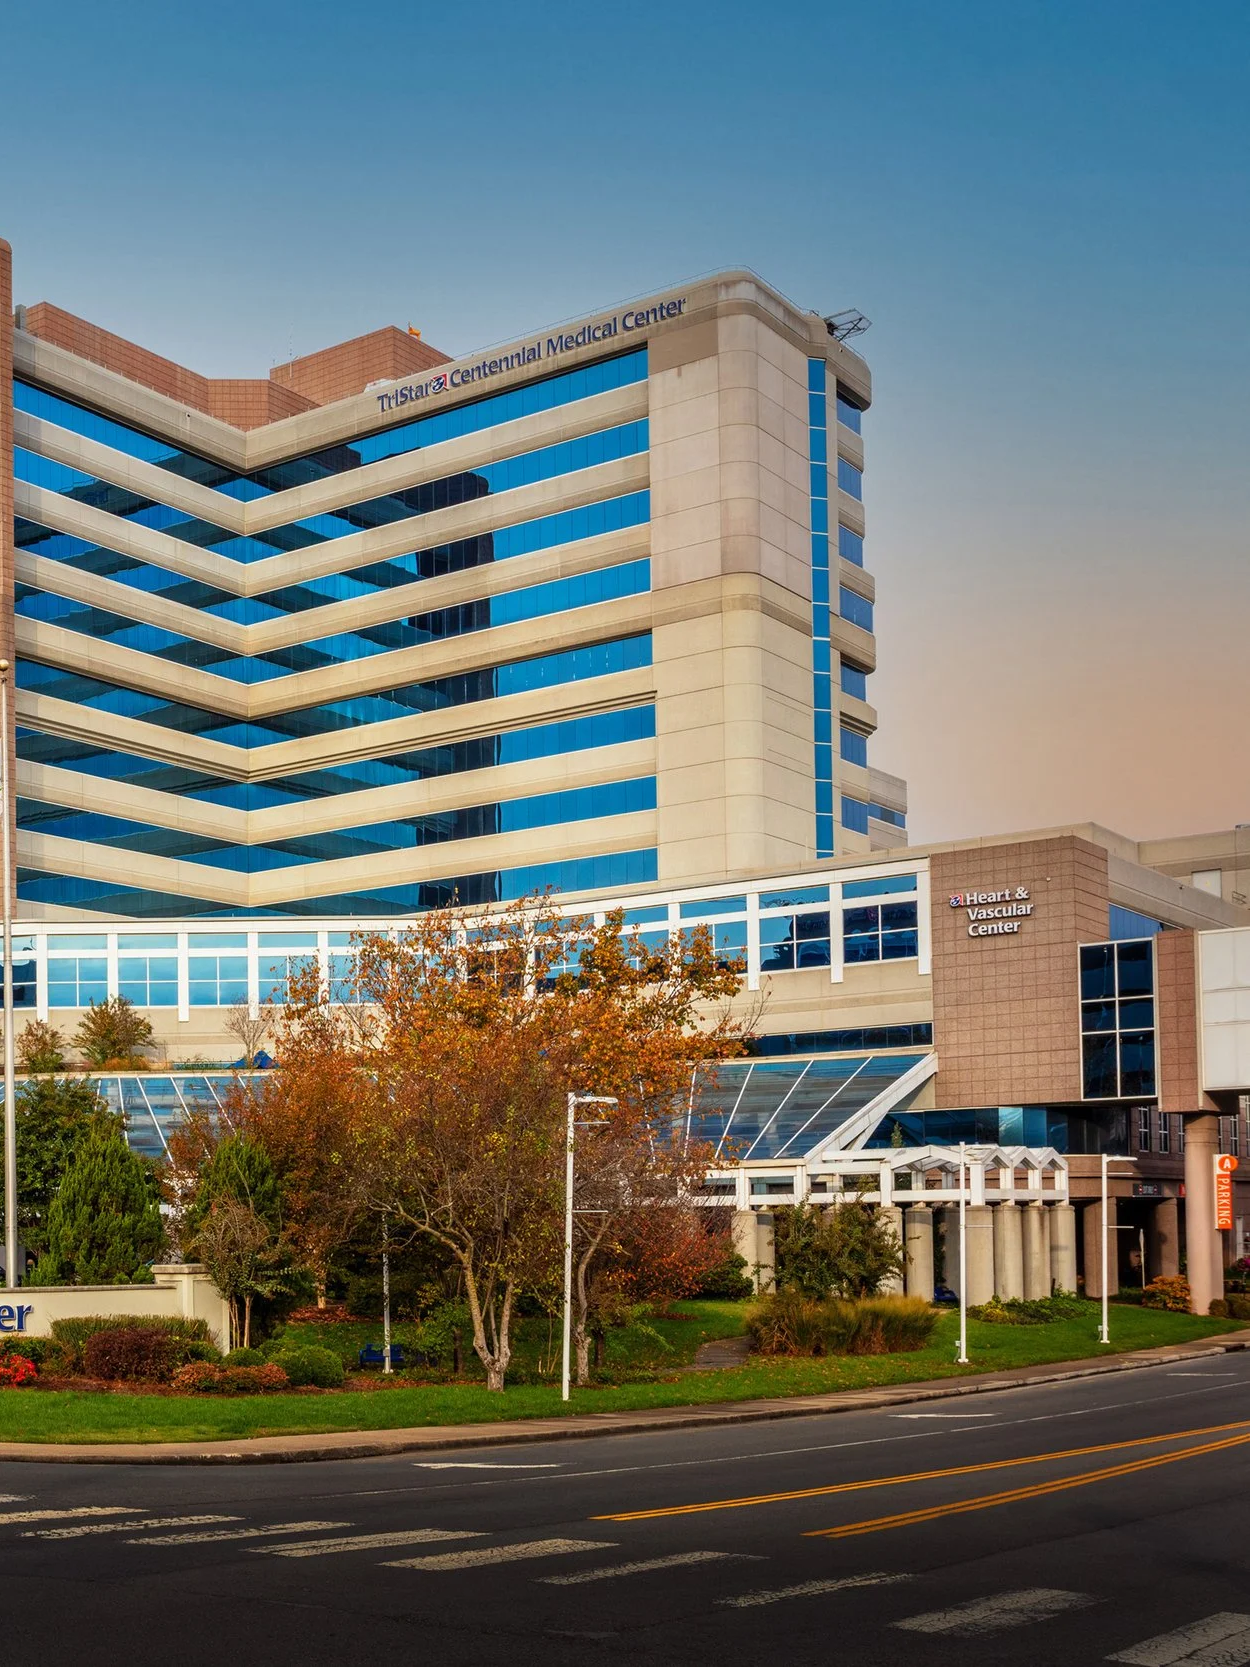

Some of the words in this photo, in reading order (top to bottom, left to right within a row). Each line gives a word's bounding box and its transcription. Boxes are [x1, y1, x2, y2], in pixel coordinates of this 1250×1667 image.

[377, 380, 434, 412] TriStar
[450, 341, 542, 387] Centennial
[547, 317, 618, 355] Medical
[622, 298, 686, 331] Center
[965, 888, 1011, 905] Heart
[1015, 886, 1029, 899] &
[967, 903, 1034, 920] Vascular
[968, 921, 1021, 937] Center
[1223, 1158, 1231, 1169] A
[1217, 1178, 1231, 1225] PARKING
